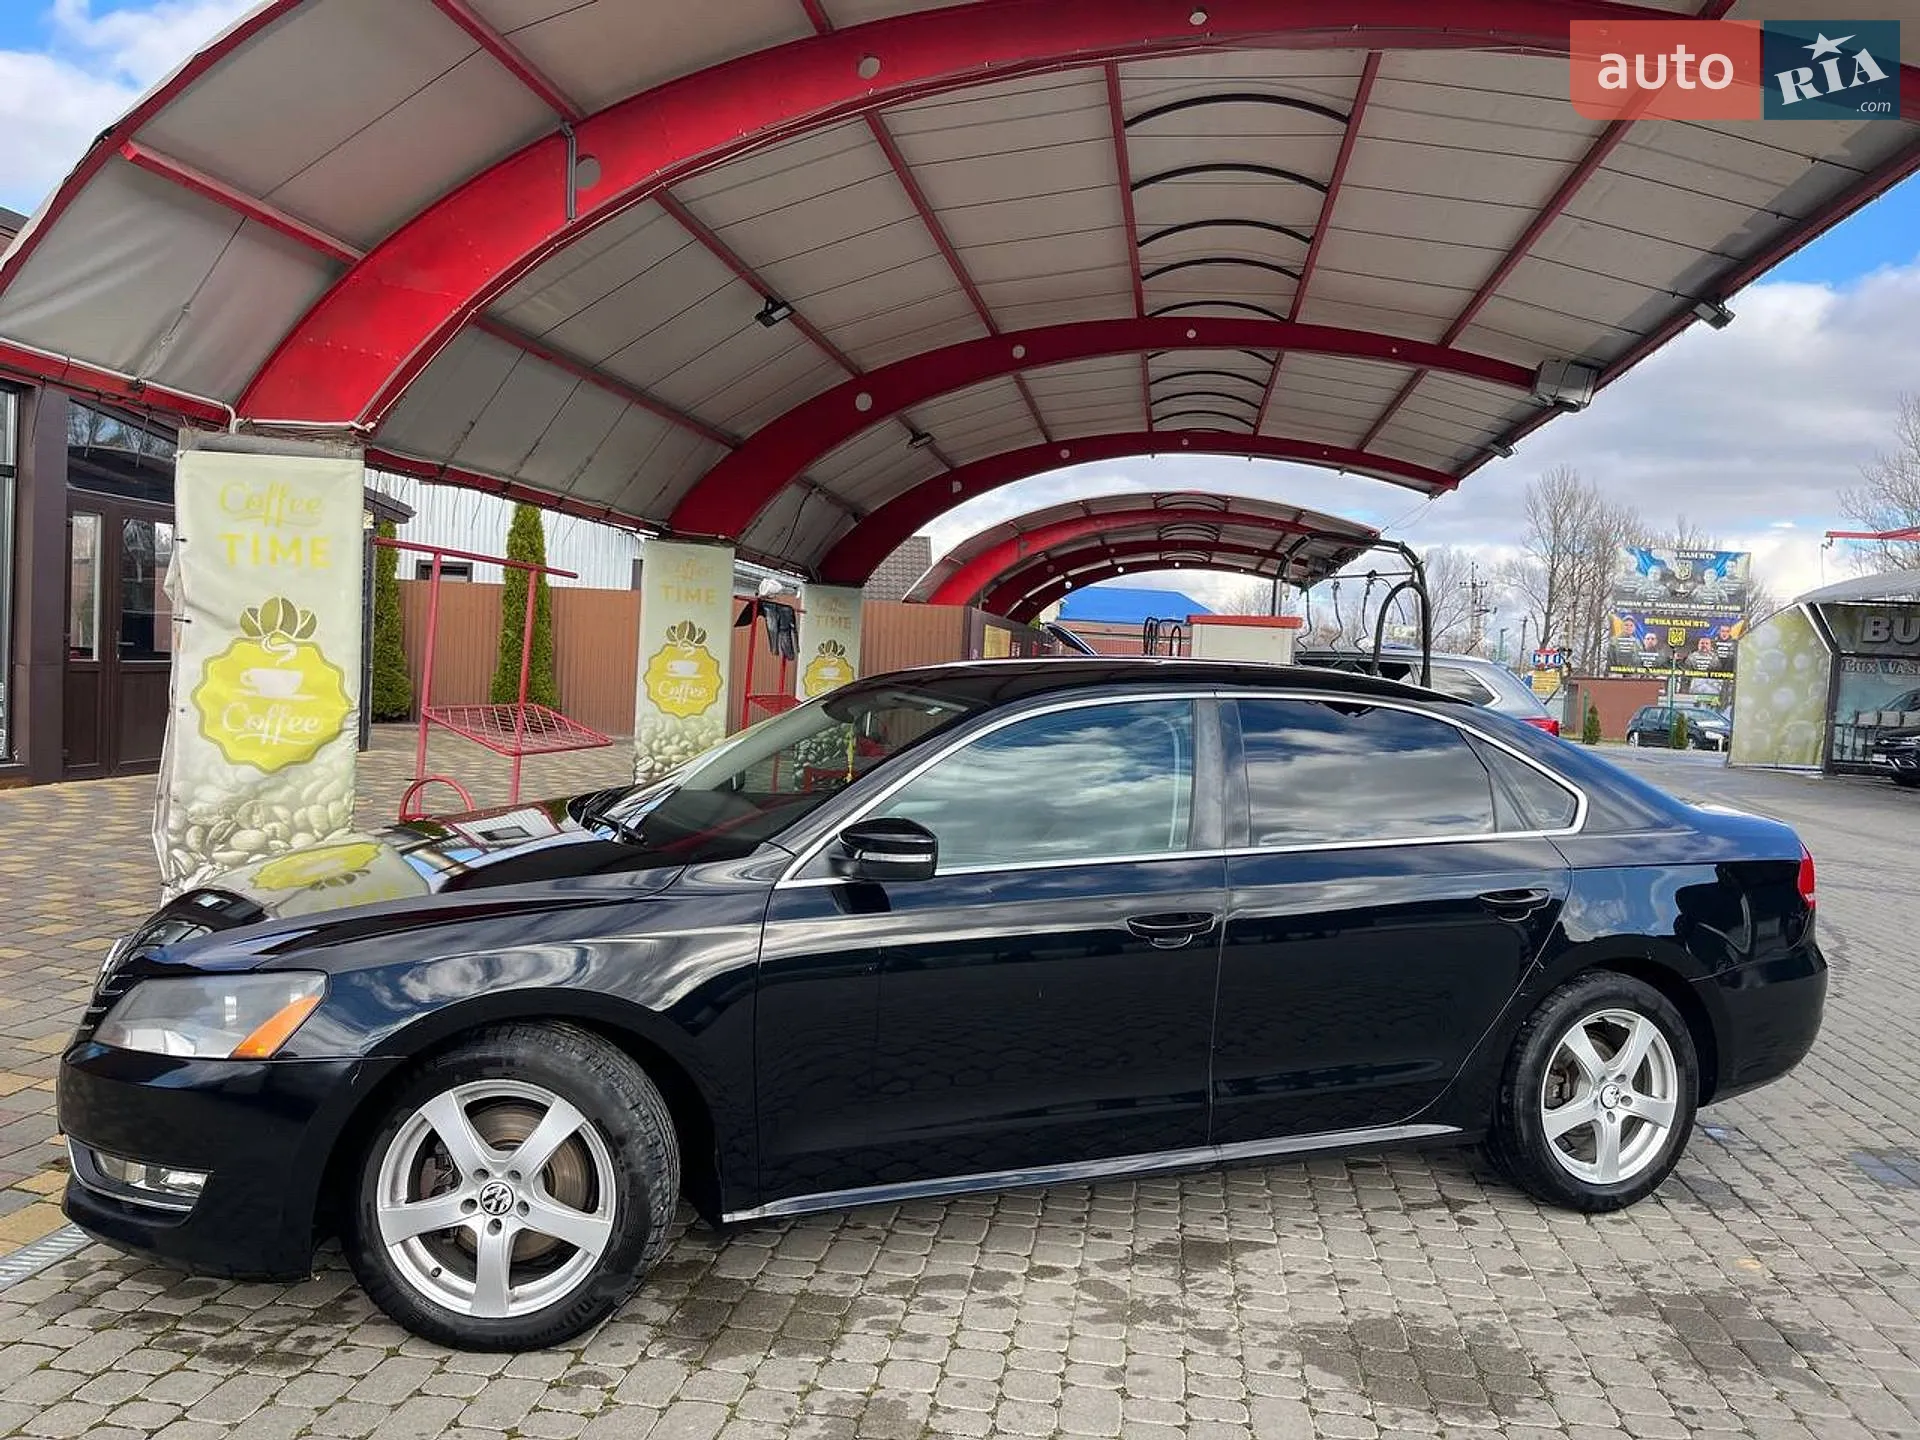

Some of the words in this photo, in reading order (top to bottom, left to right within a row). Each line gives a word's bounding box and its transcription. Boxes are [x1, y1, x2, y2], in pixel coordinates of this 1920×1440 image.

[218, 481, 324, 528] Coffee
[218, 533, 332, 570] TIME
[660, 584, 716, 606] TIME
[815, 614, 851, 629] TIME
[657, 681, 708, 704] Coffee
[221, 703, 322, 745] Coffee
